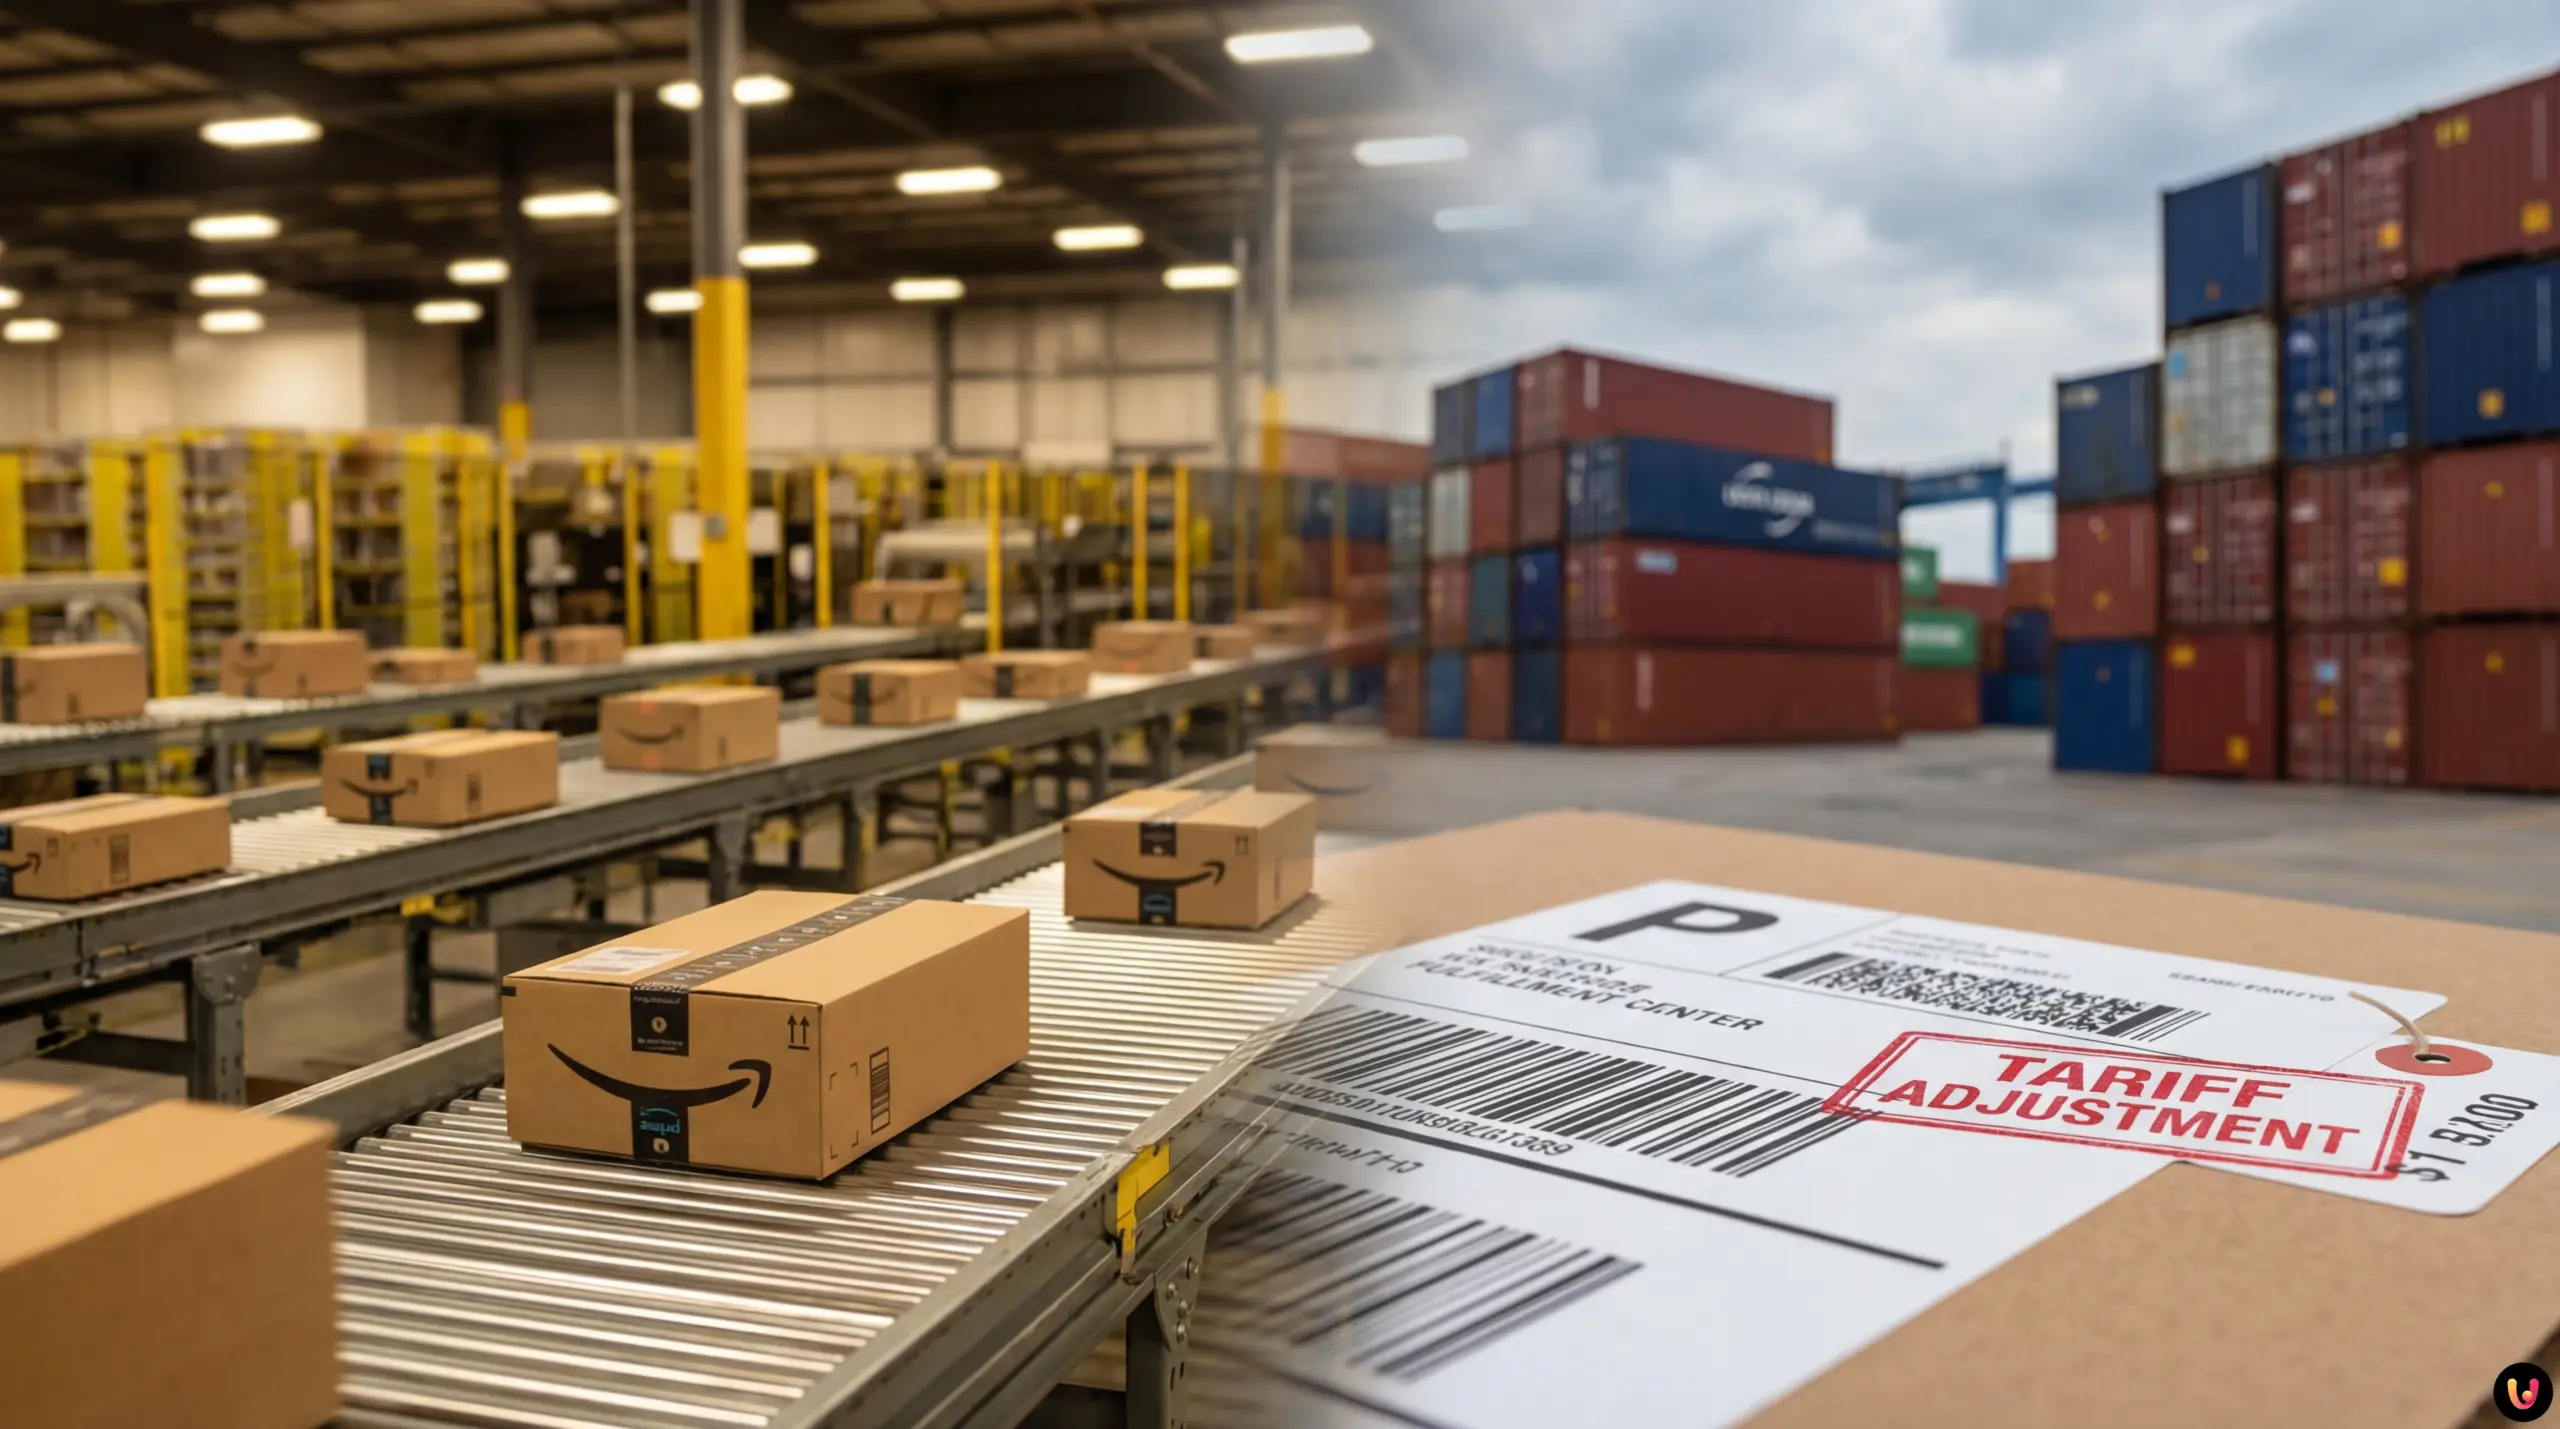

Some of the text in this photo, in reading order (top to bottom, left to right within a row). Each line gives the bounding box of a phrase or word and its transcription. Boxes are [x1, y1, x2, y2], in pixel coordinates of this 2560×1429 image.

[1571, 901, 1780, 942] P
[1406, 959, 1626, 1004] FULFILLMENT
[1996, 1053, 2291, 1109] TARIFF
[1878, 1079, 2361, 1155] ADJUSTMENT
